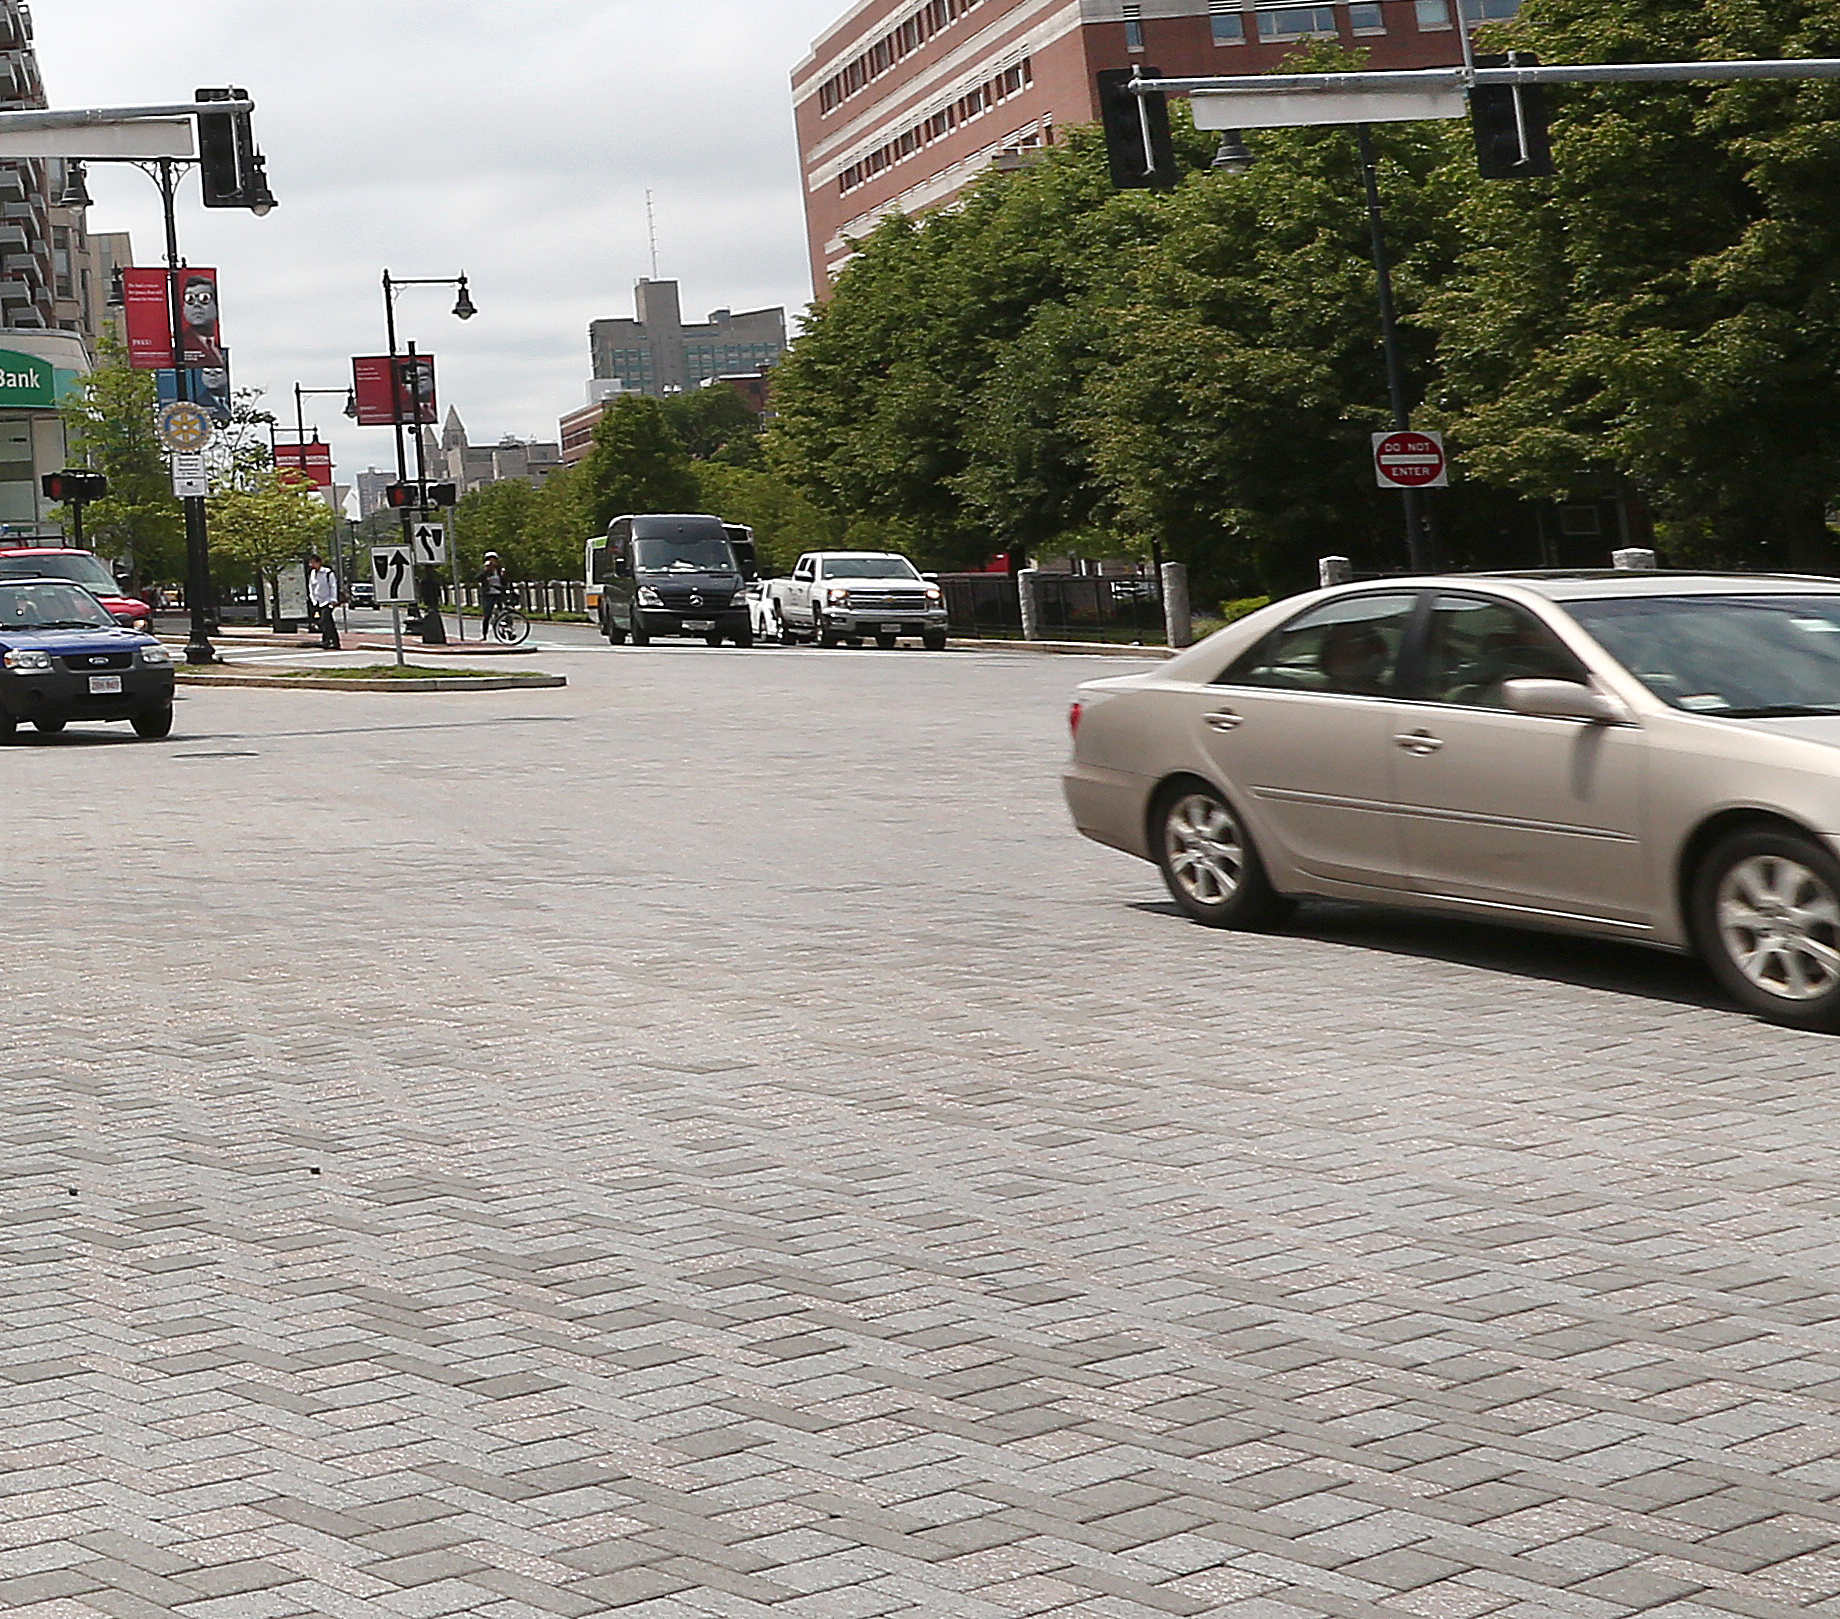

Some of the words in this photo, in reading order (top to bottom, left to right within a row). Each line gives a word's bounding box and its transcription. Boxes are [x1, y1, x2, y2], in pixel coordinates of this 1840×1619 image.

[1385, 443, 1400, 452] DO
[1407, 442, 1430, 451] NOT
[1392, 467, 1431, 476] ENTER
